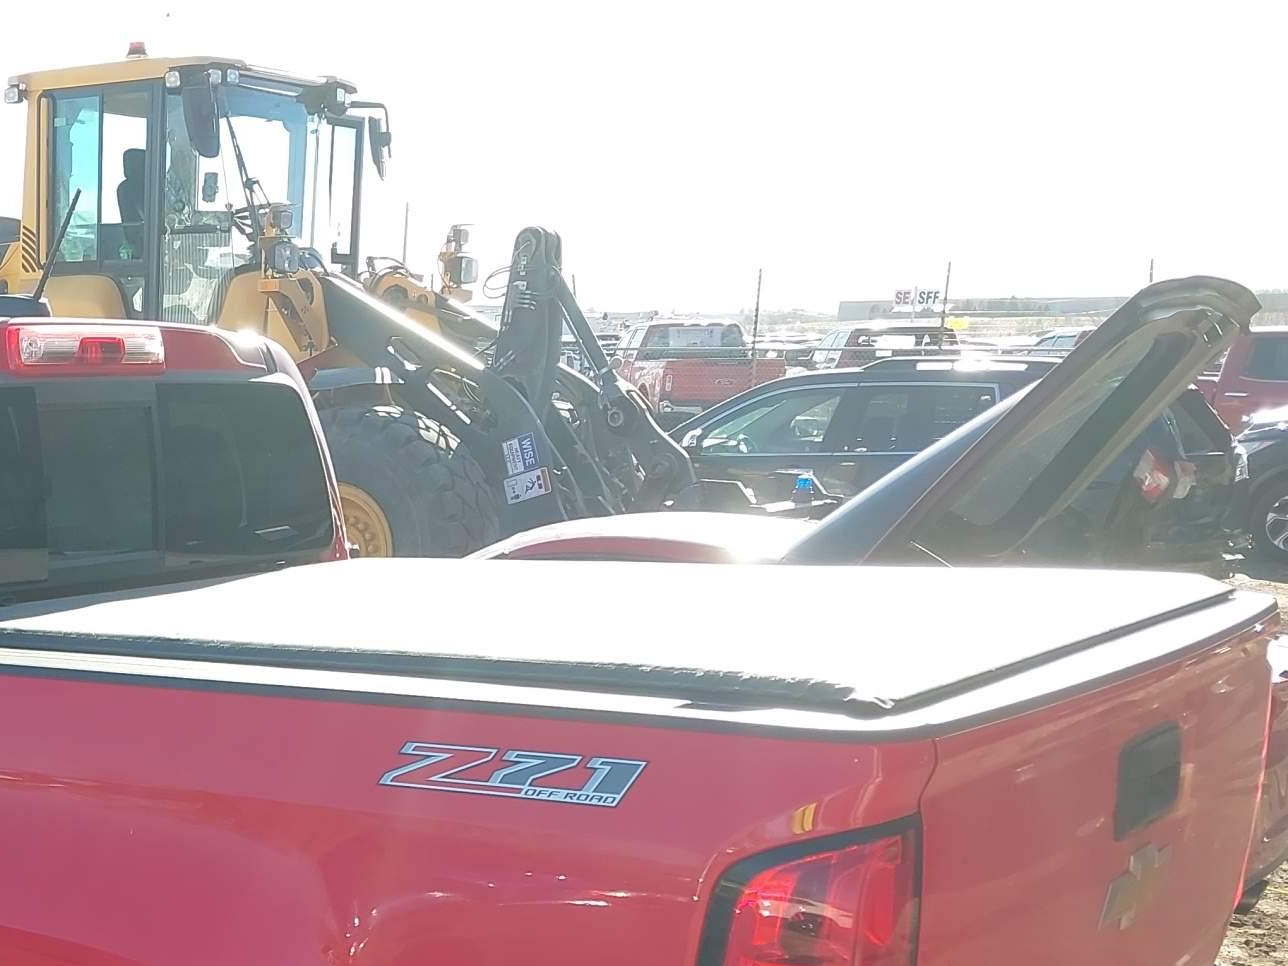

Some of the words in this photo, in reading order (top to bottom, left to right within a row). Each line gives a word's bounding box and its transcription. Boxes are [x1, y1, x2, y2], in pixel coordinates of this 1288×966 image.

[520, 437, 536, 467] WISE
[377, 741, 648, 808] Z71
[523, 788, 561, 799] OFF
[563, 792, 617, 805] ROAD
